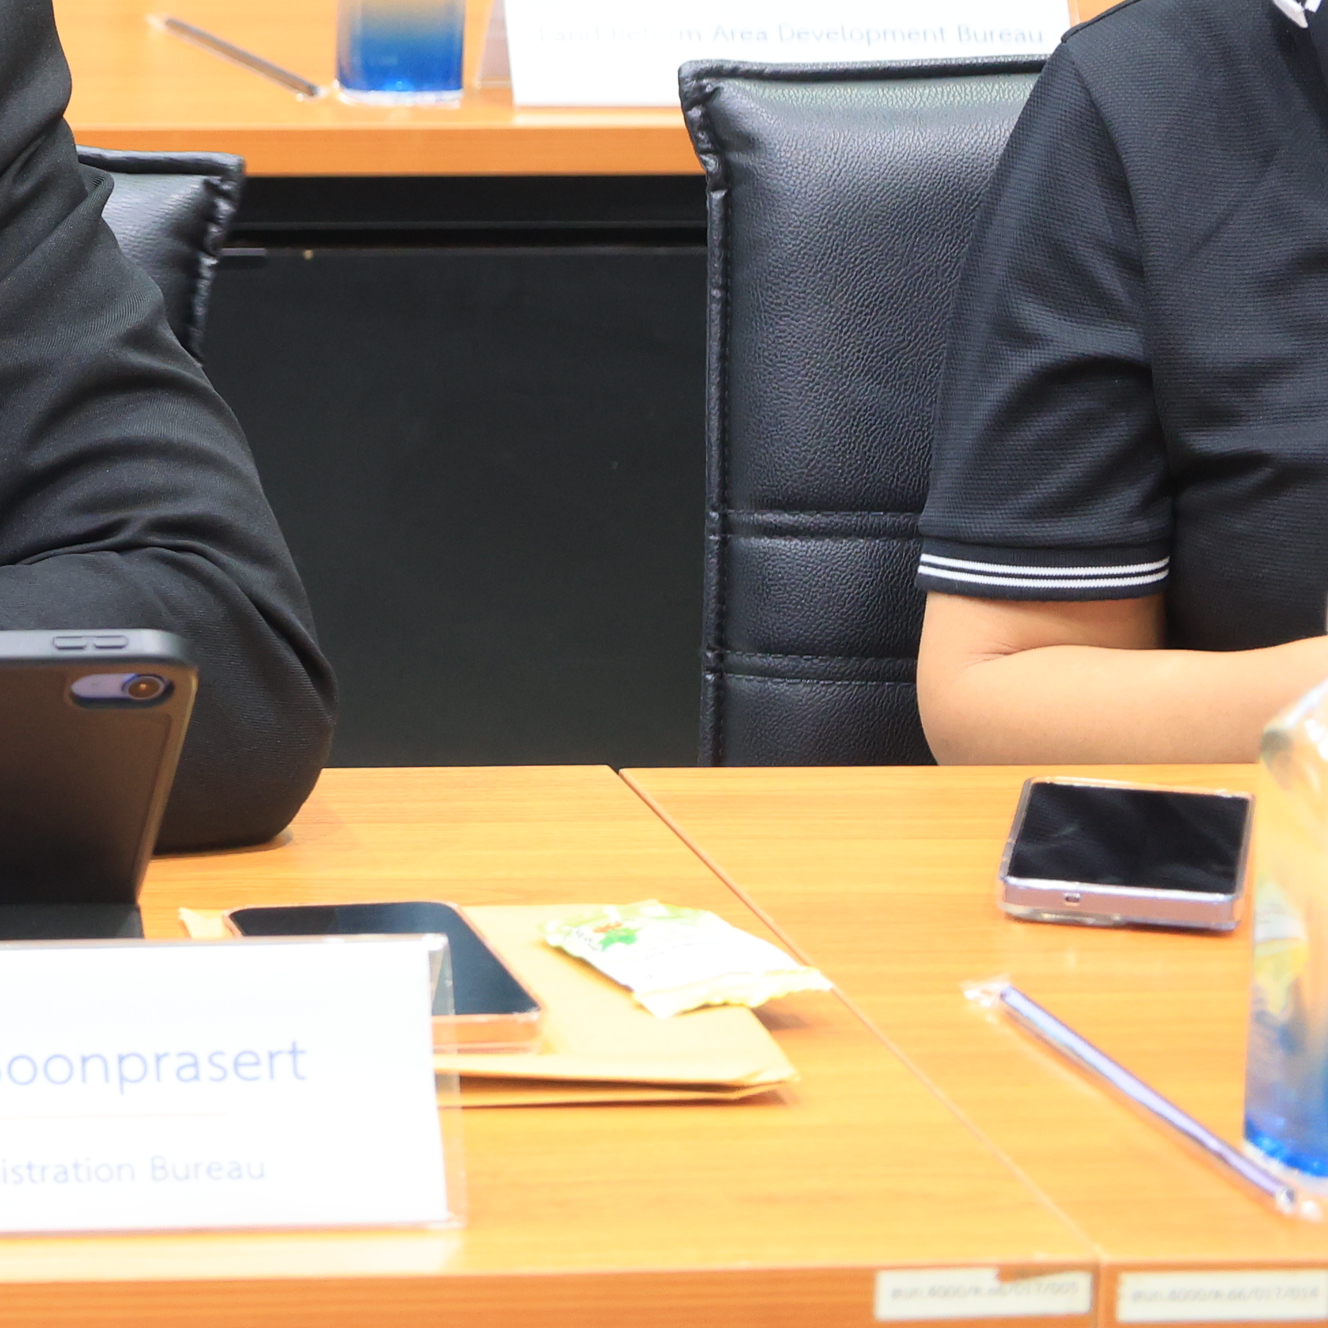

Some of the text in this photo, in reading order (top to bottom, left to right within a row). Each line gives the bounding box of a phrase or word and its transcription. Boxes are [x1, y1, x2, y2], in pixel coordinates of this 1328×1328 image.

[712, 23, 769, 43] Area
[777, 22, 946, 48] Development
[956, 22, 1044, 44] Bureau
[150, 1154, 266, 1183] Bureau
